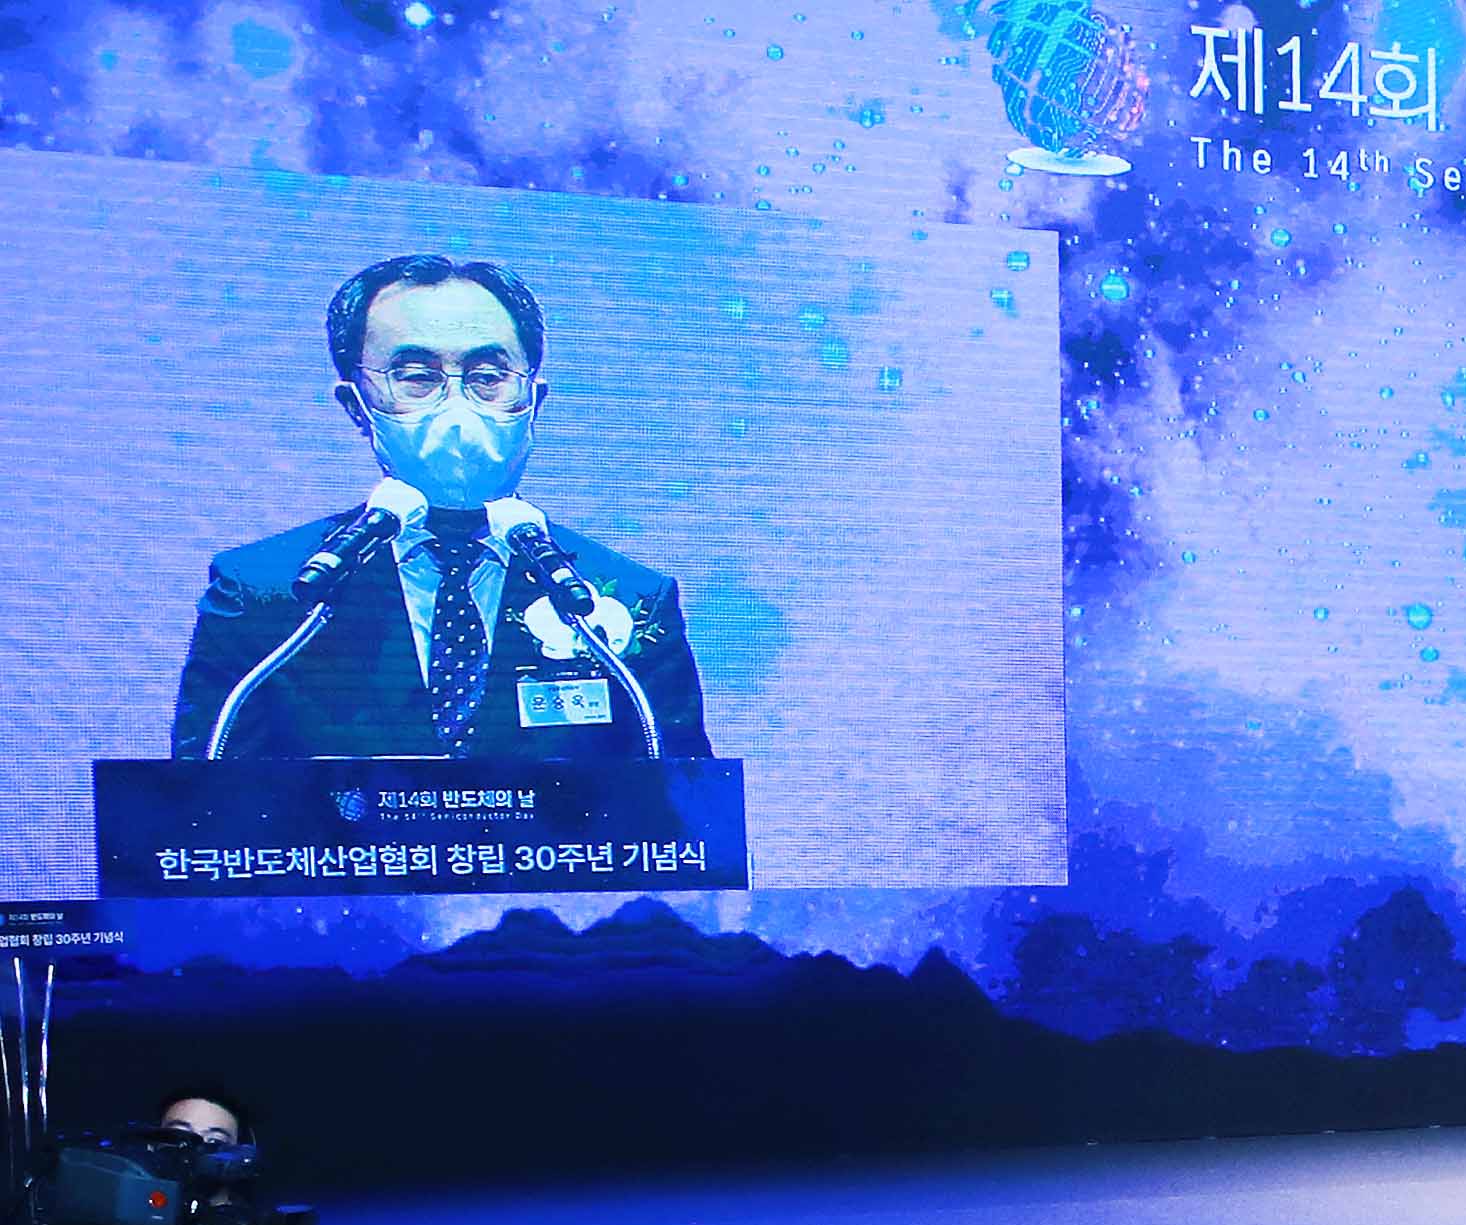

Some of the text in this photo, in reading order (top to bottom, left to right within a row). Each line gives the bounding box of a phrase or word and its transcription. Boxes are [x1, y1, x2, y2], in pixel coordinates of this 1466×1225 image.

[1189, 24, 1437, 132] 제14회
[1189, 136, 1273, 175] The
[1301, 147, 1391, 182] 14th
[441, 789, 513, 809] 반도체의
[517, 789, 536, 809] 날
[155, 840, 707, 881] 한국반도체산업협회 창립 30주년 기념식
[55, 931, 92, 945] 30주년
[92, 930, 125, 944] 기념식
